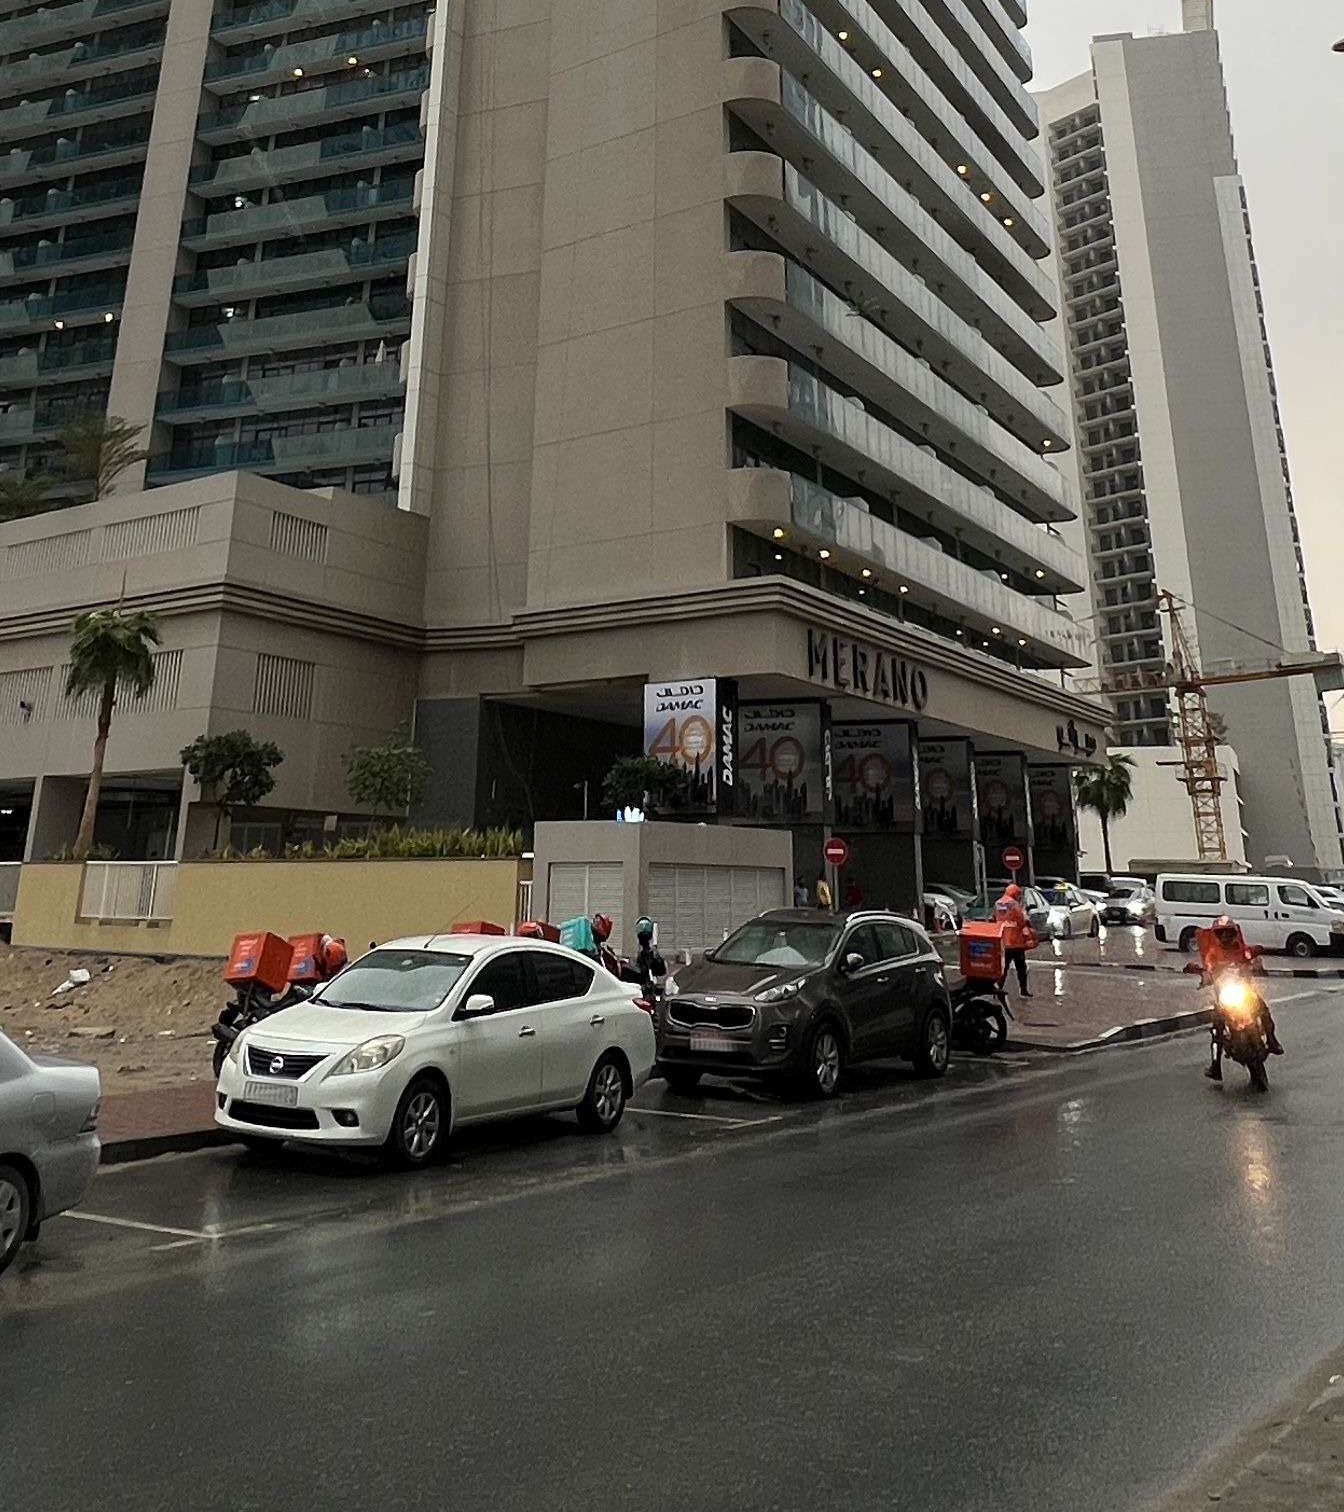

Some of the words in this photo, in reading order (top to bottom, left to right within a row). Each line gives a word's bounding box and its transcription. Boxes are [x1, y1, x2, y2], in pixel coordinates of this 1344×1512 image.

[807, 629, 927, 712] MERANO
[656, 699, 703, 712] DAMAC
[648, 715, 712, 765] 40
[722, 706, 733, 786] DAMAC
[737, 736, 804, 781] 40
